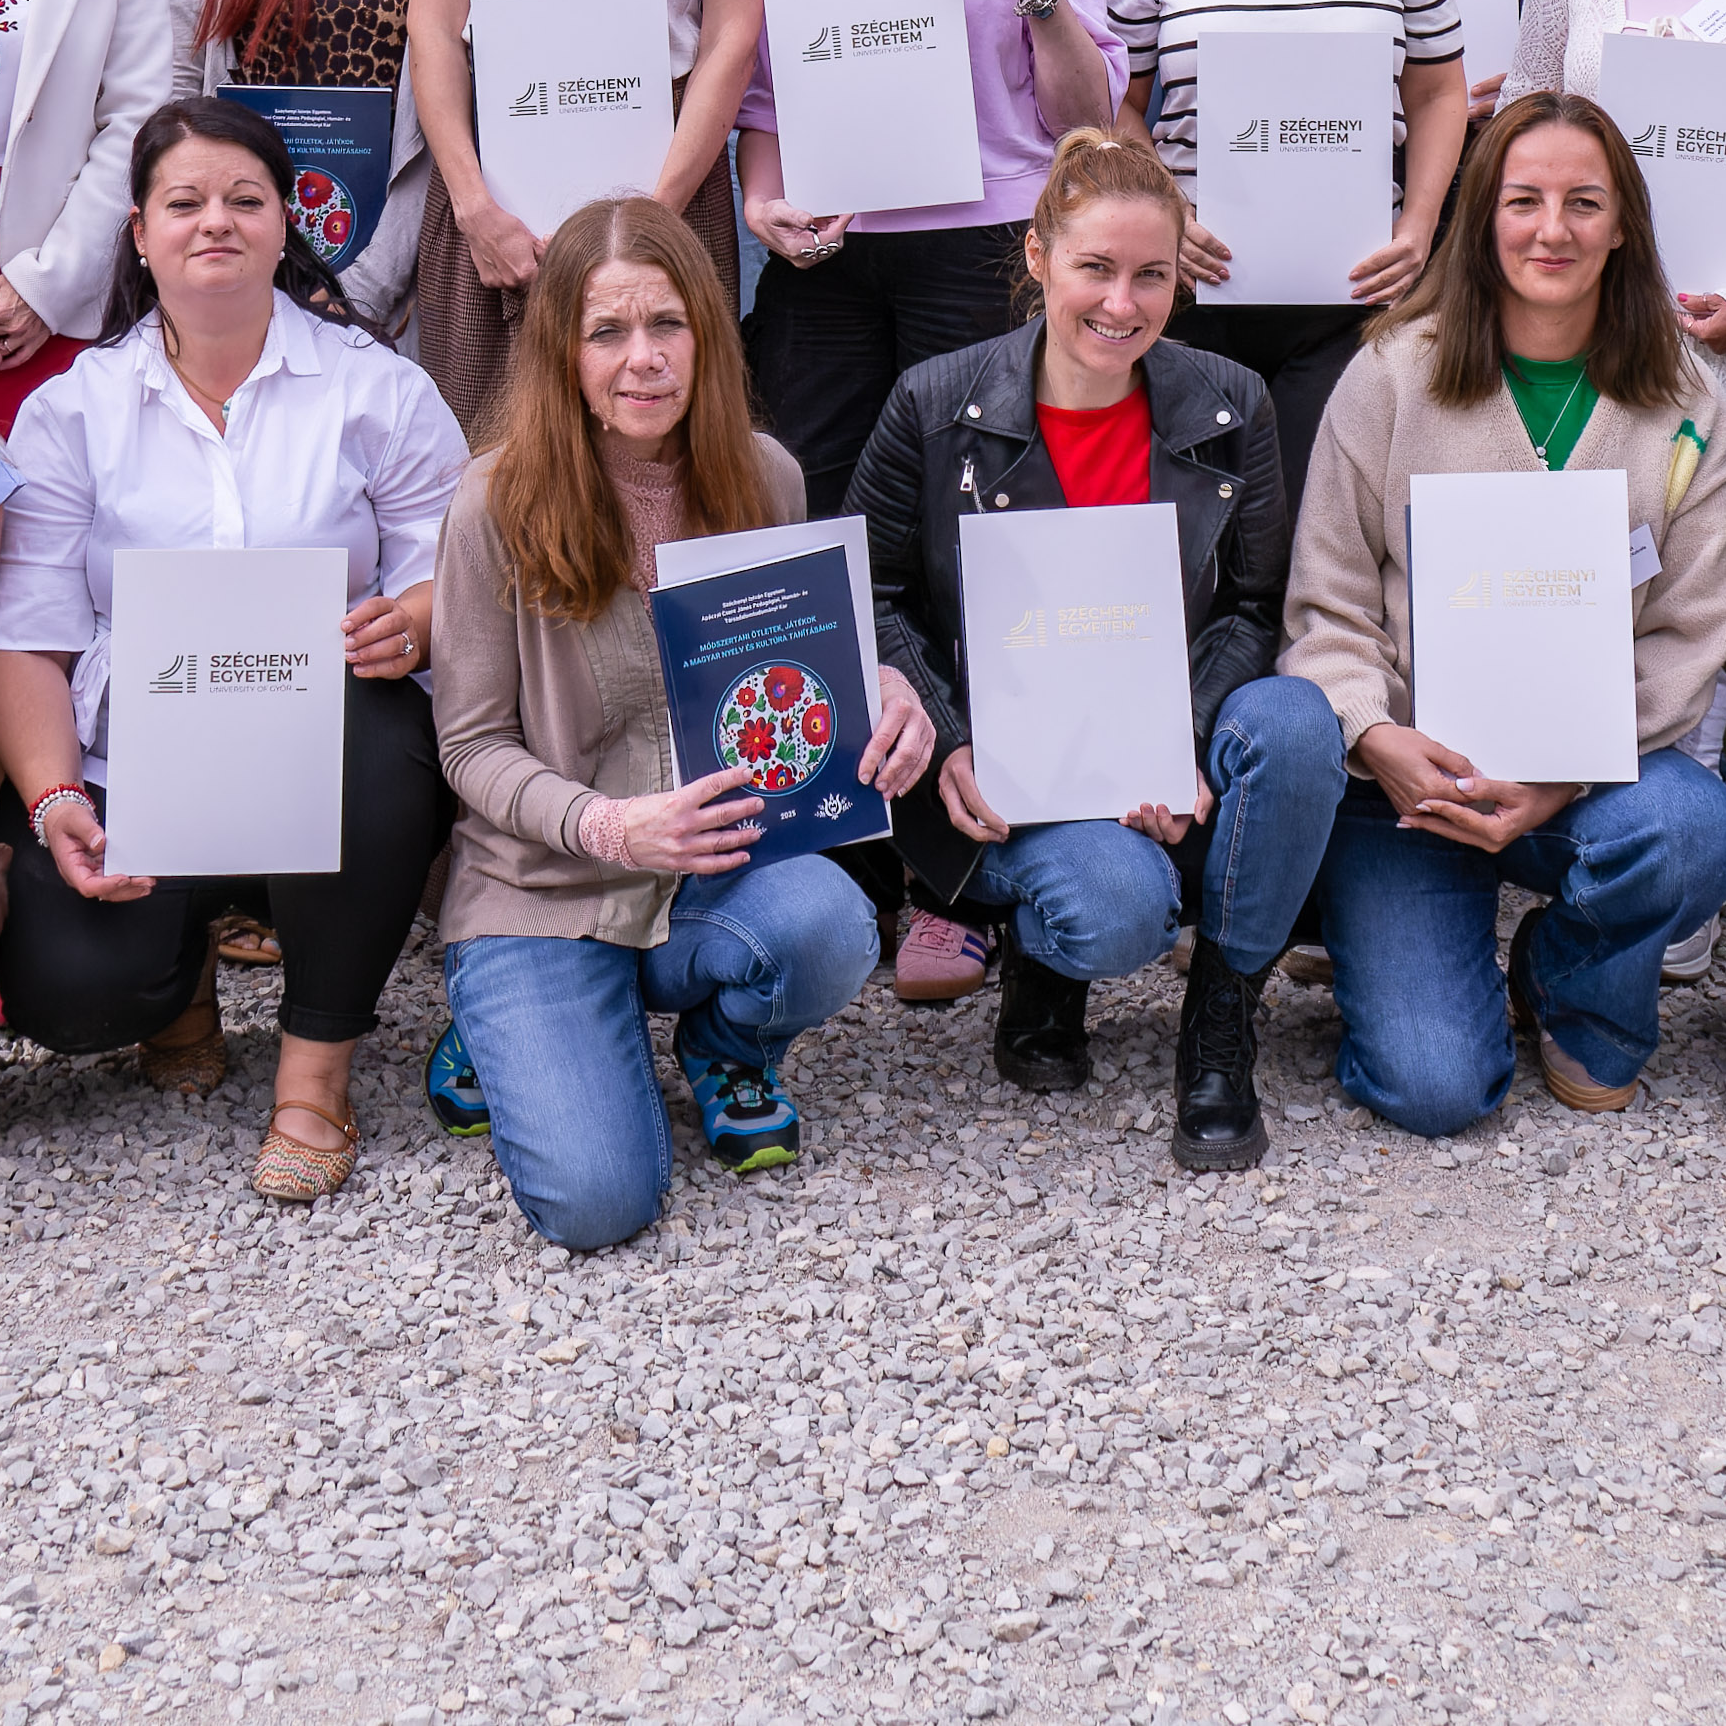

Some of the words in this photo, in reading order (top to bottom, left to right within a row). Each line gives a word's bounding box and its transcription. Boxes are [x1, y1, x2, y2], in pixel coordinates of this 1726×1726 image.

[851, 16, 935, 35] SZÉCHENYI
[852, 31, 922, 49] EGYETEM
[853, 47, 892, 57] UNIVERSITY
[558, 77, 641, 93] SZÉCHENYI
[559, 91, 628, 105] EGYETEM
[559, 105, 599, 114] UNIVERSITY
[1279, 117, 1362, 131] SZÉCHENYI
[1280, 133, 1348, 144] EGYETEM
[1675, 154, 1715, 163] UNIVERSITY
[1502, 567, 1595, 582] SZÉCHENYI
[1503, 583, 1581, 597] EGYETEM
[722, 597, 748, 609] Széchenyi
[763, 588, 786, 599] Egyetem
[779, 603, 788, 611] Kar
[1057, 603, 1151, 621] SZÉCHENYI
[699, 633, 750, 652] MÓDSZERTANI
[751, 624, 784, 638] ÖTLETEK,
[785, 615, 817, 630] JÁTÉKOK
[1058, 619, 1135, 635] EGYETEM
[683, 660, 689, 668] A
[689, 651, 721, 666] MAGYAR
[721, 645, 744, 659] NYELV
[745, 642, 755, 652] ÉS
[755, 634, 788, 649] KULTÚRA
[789, 621, 837, 640] TANÍTÁSÁHOZ
[210, 651, 309, 668] SZÉCHENYI
[210, 669, 292, 683] EGYETEM
[209, 685, 255, 693] UNIVERSITY
[780, 810, 796, 820] 2025
